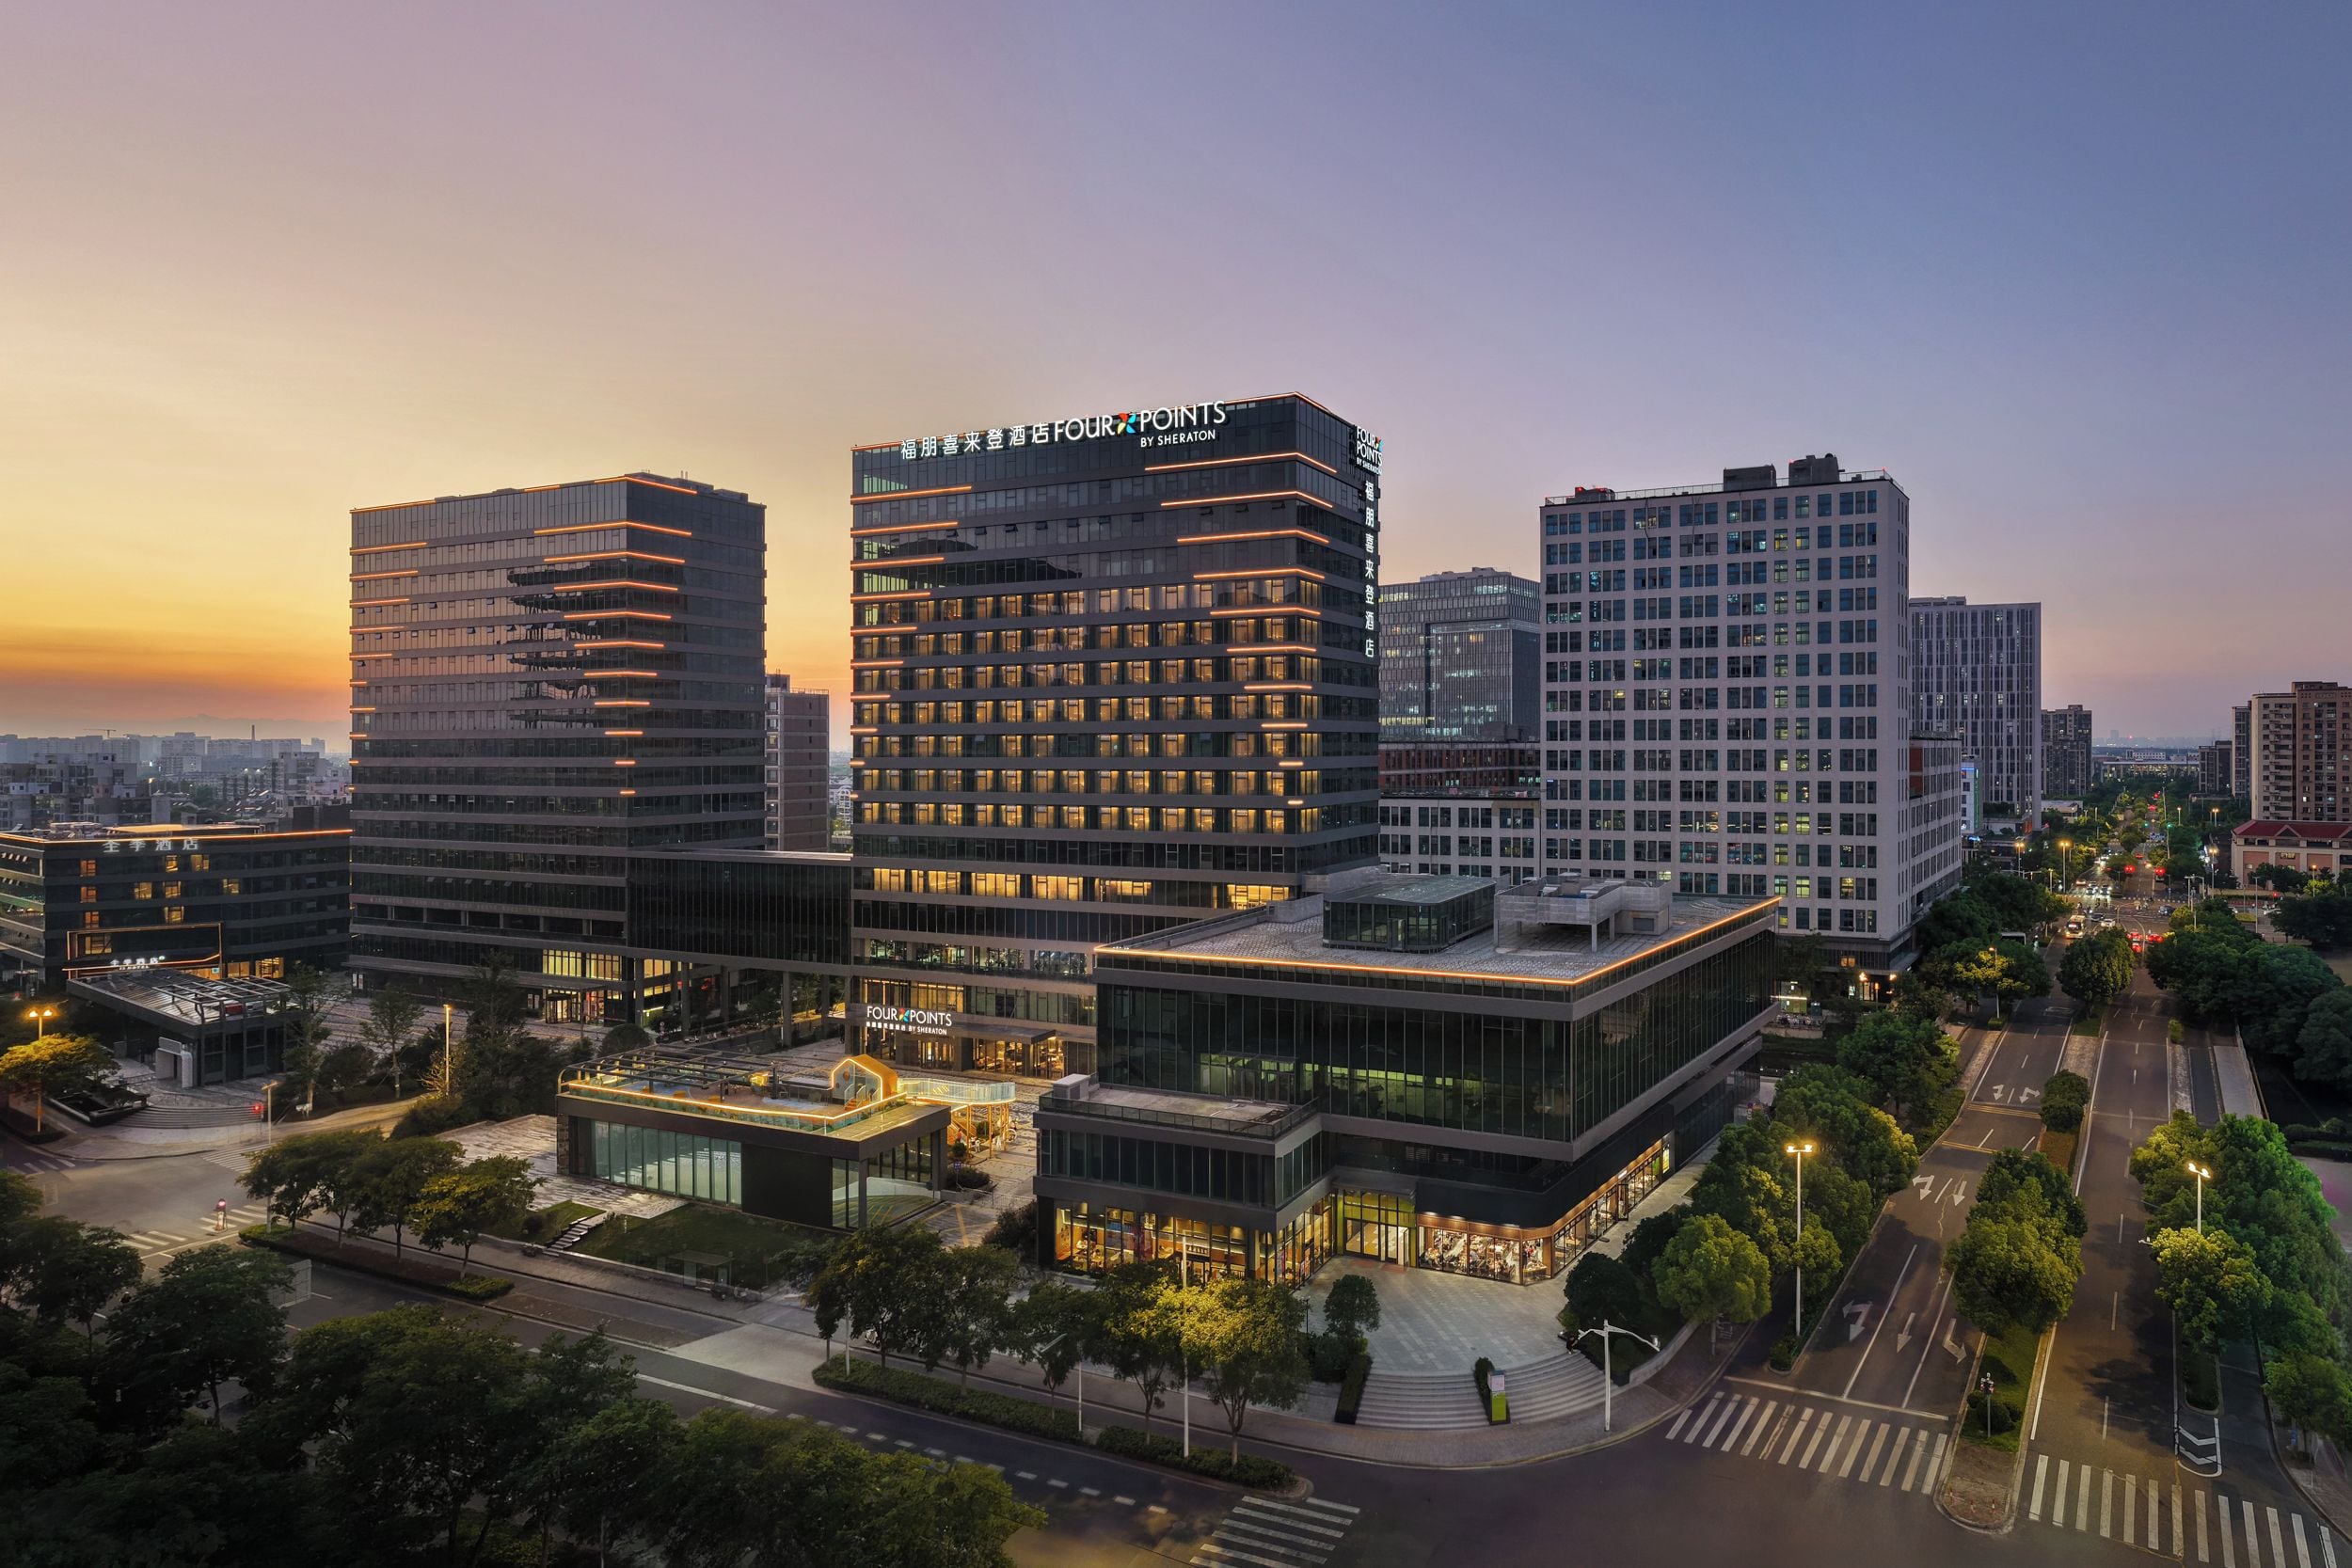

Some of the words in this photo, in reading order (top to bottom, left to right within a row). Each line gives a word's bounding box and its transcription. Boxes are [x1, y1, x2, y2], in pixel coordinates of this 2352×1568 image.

[1054, 414, 1116, 442] FOUR
[1139, 400, 1226, 432] POINTS
[900, 421, 1049, 460] 福朋喜来登酒店
[1140, 436, 1154, 448] BY
[1157, 429, 1216, 446] SHERATON
[1356, 425, 1376, 449] FOUR
[1356, 440, 1383, 467] POINTS
[1364, 480, 1375, 658] 福朋喜来登酒店
[866, 1006, 898, 1022] FOUR
[910, 1009, 952, 1026] POINTS
[916, 1025, 947, 1036] SHERATON
